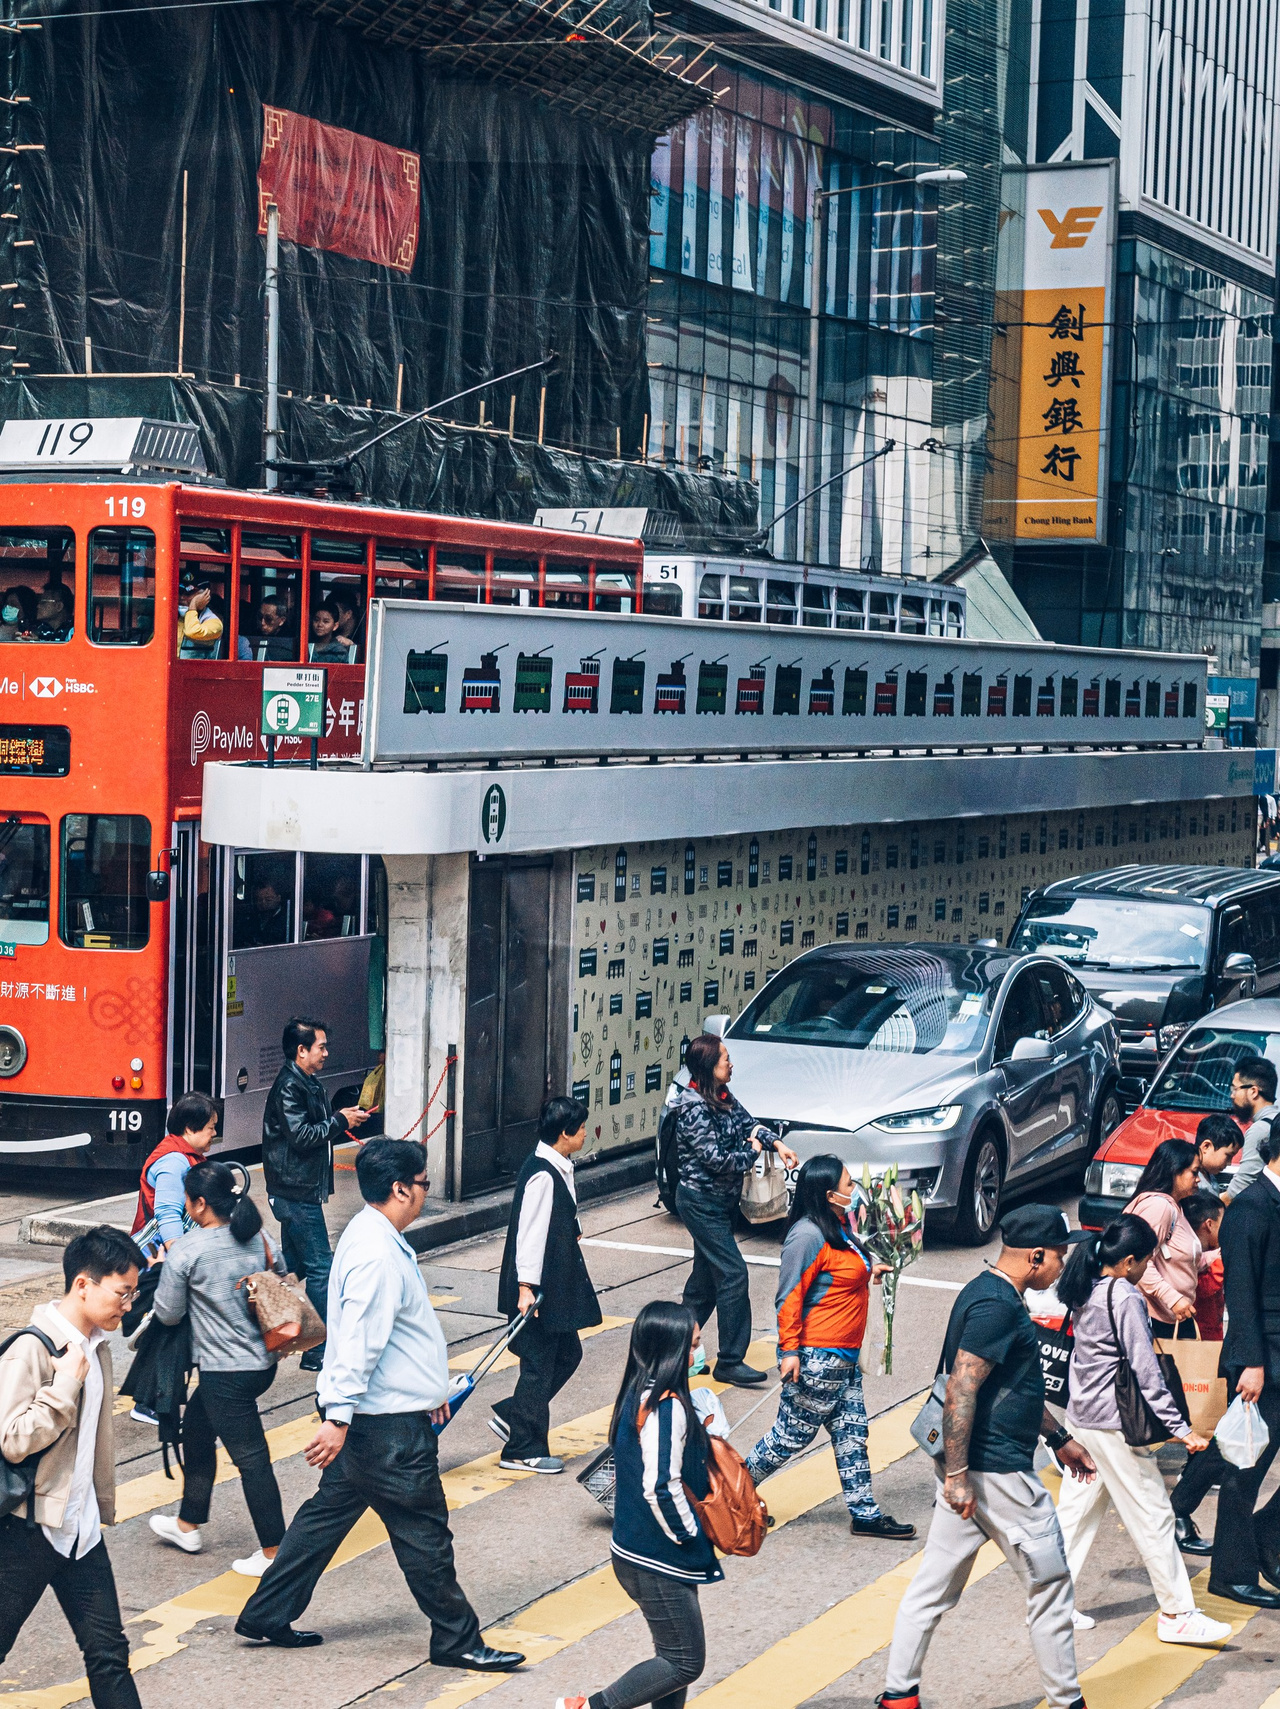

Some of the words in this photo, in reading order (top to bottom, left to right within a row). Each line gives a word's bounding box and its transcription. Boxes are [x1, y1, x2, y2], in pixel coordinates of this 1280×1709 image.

[1040, 303, 1086, 481] 創興銀行
[36, 421, 95, 457] 119
[105, 496, 146, 518] 119
[570, 510, 604, 534] 51
[1024, 516, 1050, 525] Chong
[1052, 516, 1071, 525] Hing
[1073, 516, 1093, 524] Bank
[659, 565, 678, 579] 51
[305, 694, 320, 703] 27E
[213, 725, 254, 754] PayMe
[109, 1110, 143, 1131] 119
